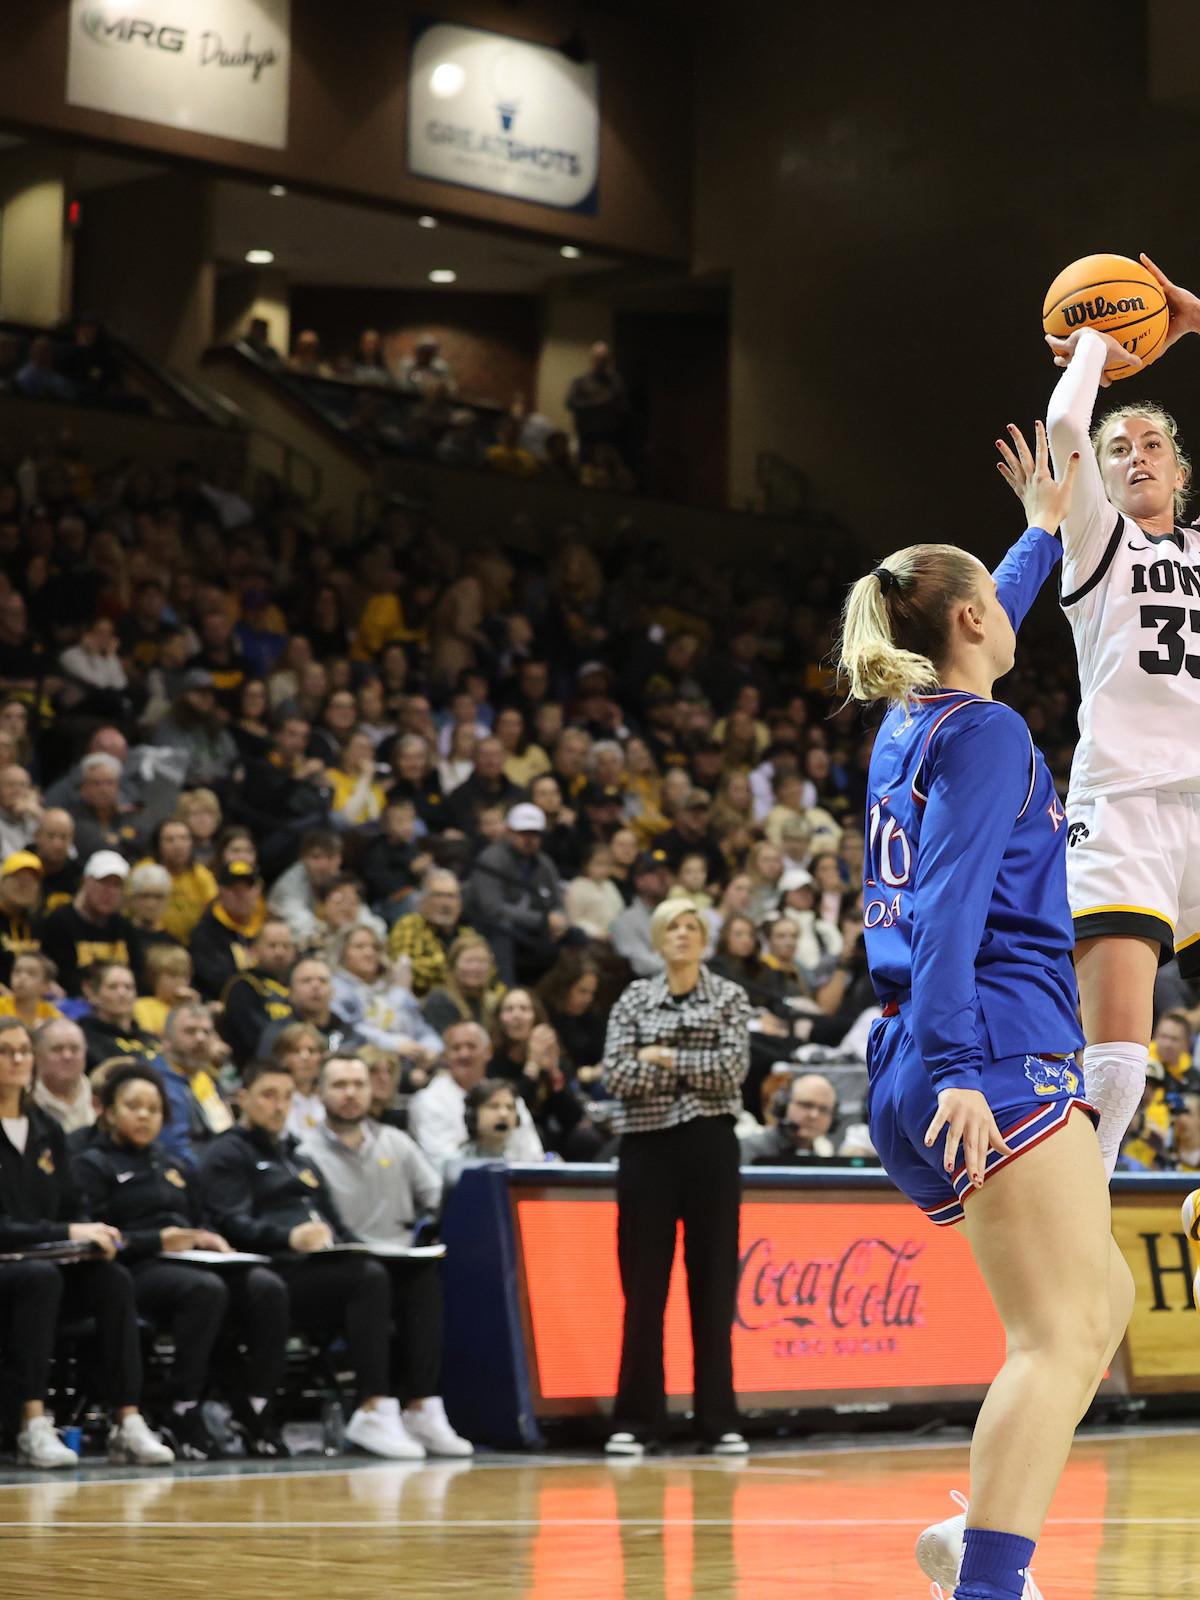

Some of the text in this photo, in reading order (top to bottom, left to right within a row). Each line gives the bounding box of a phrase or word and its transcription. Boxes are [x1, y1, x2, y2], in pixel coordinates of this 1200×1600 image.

[95, 16, 186, 53] MRG
[1061, 295, 1146, 328] Wilson
[734, 1237, 926, 1330] Coca-Cola
